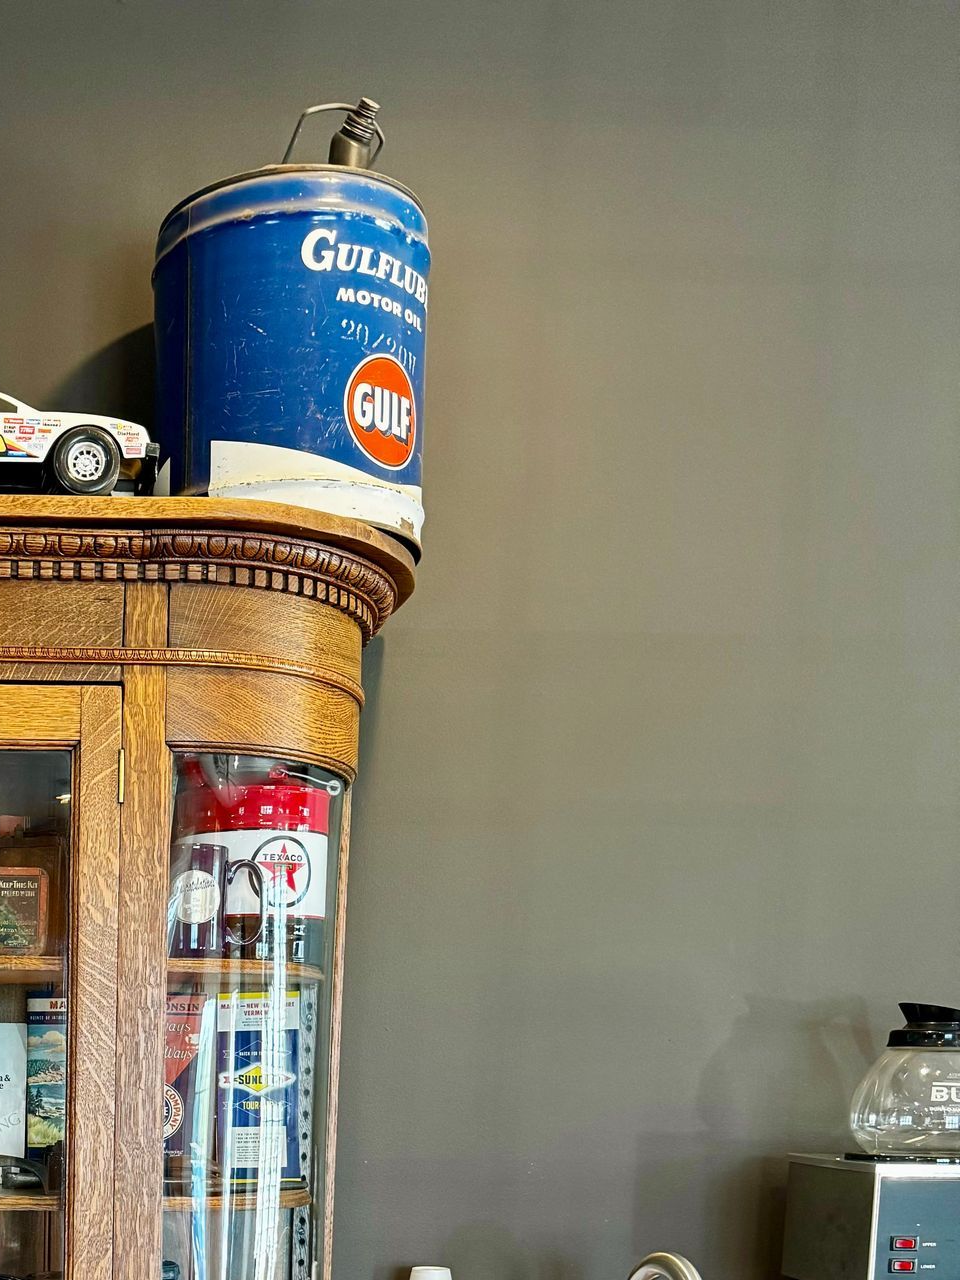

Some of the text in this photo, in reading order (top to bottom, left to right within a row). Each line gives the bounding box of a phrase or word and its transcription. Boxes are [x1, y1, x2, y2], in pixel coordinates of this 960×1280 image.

[336, 287, 423, 333] MOTOR OIL
[352, 381, 411, 445] GULF
[262, 852, 303, 862] TEXACO
[165, 1090, 179, 1132] COMPANY
[930, 1085, 960, 1103] BU
